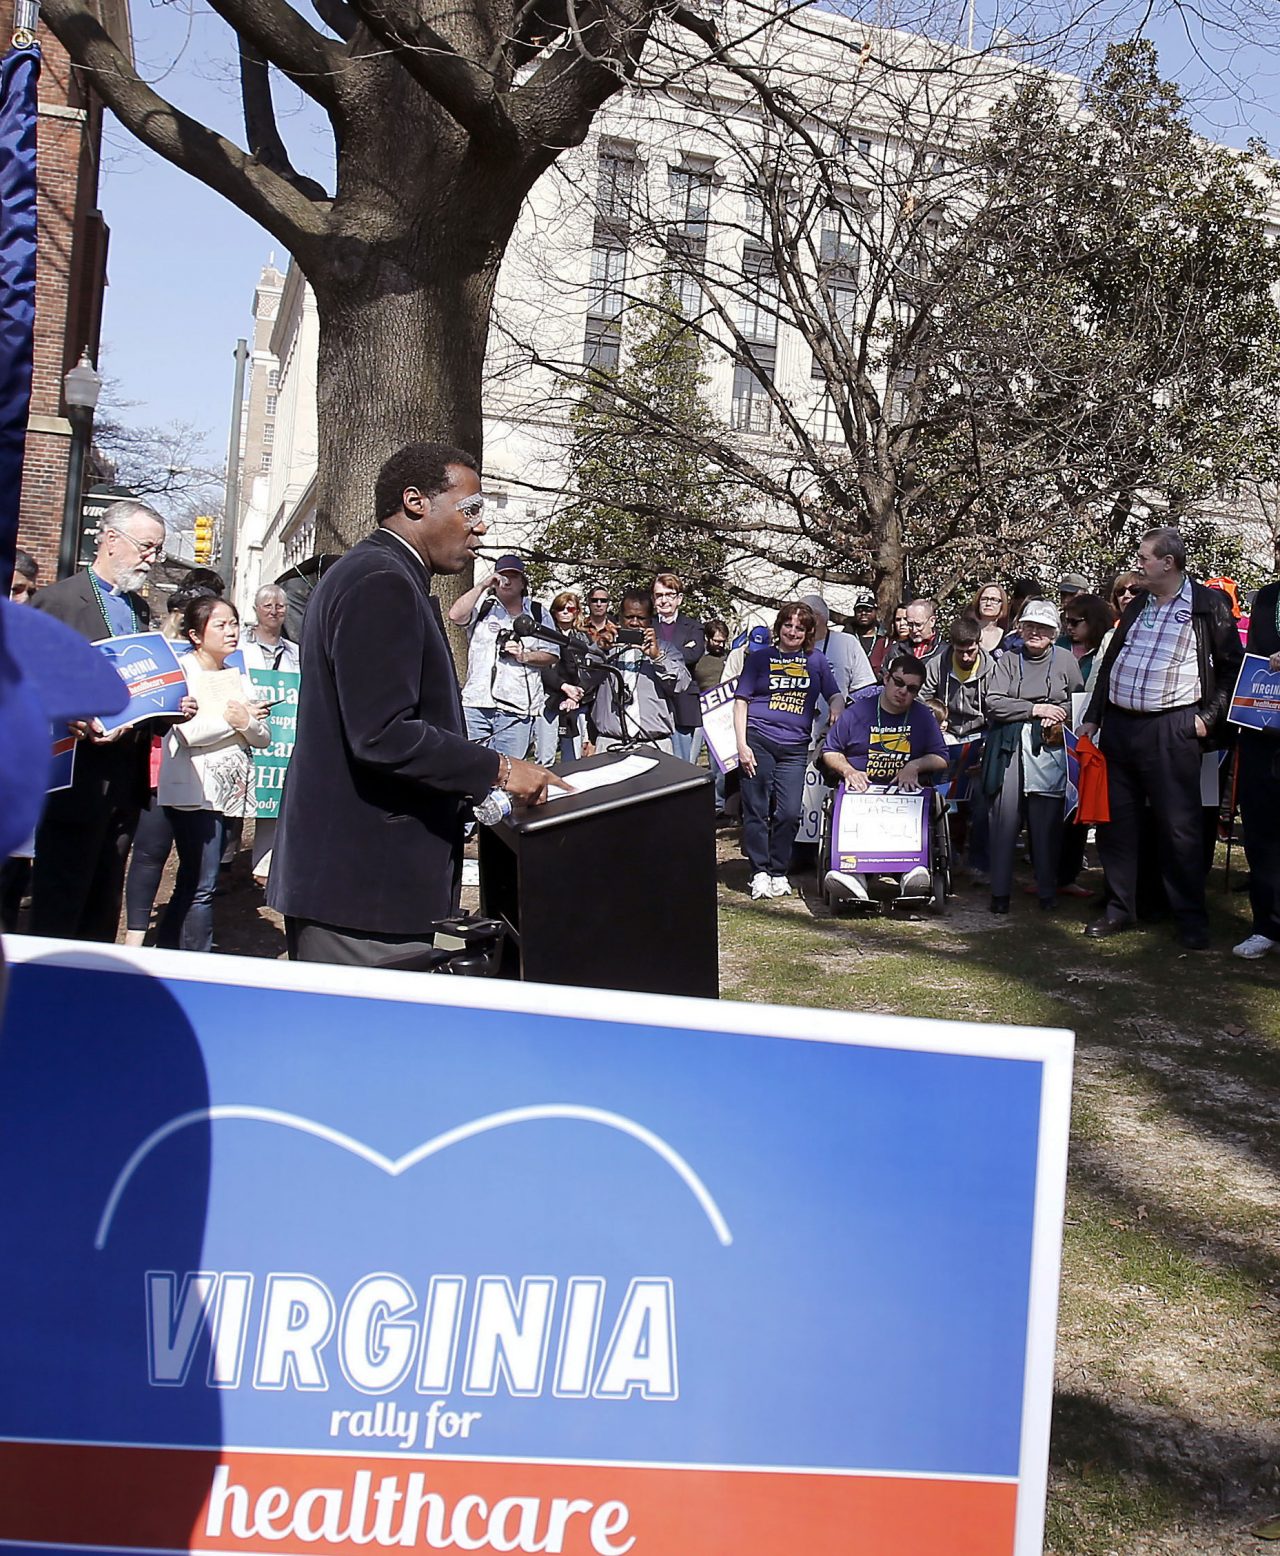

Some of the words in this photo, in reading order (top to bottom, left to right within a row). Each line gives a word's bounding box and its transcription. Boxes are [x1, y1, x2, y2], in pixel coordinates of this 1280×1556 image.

[768, 677, 811, 690] SEIU
[768, 701, 805, 715] WORK!
[870, 725, 897, 734] Virginia
[866, 760, 905, 769] POLITICS
[866, 768, 901, 777] WOR
[144, 1270, 680, 1401] VIRGINIA
[329, 1402, 419, 1449] rally
[422, 1402, 483, 1450] for
[206, 1464, 637, 1555] healthcare
